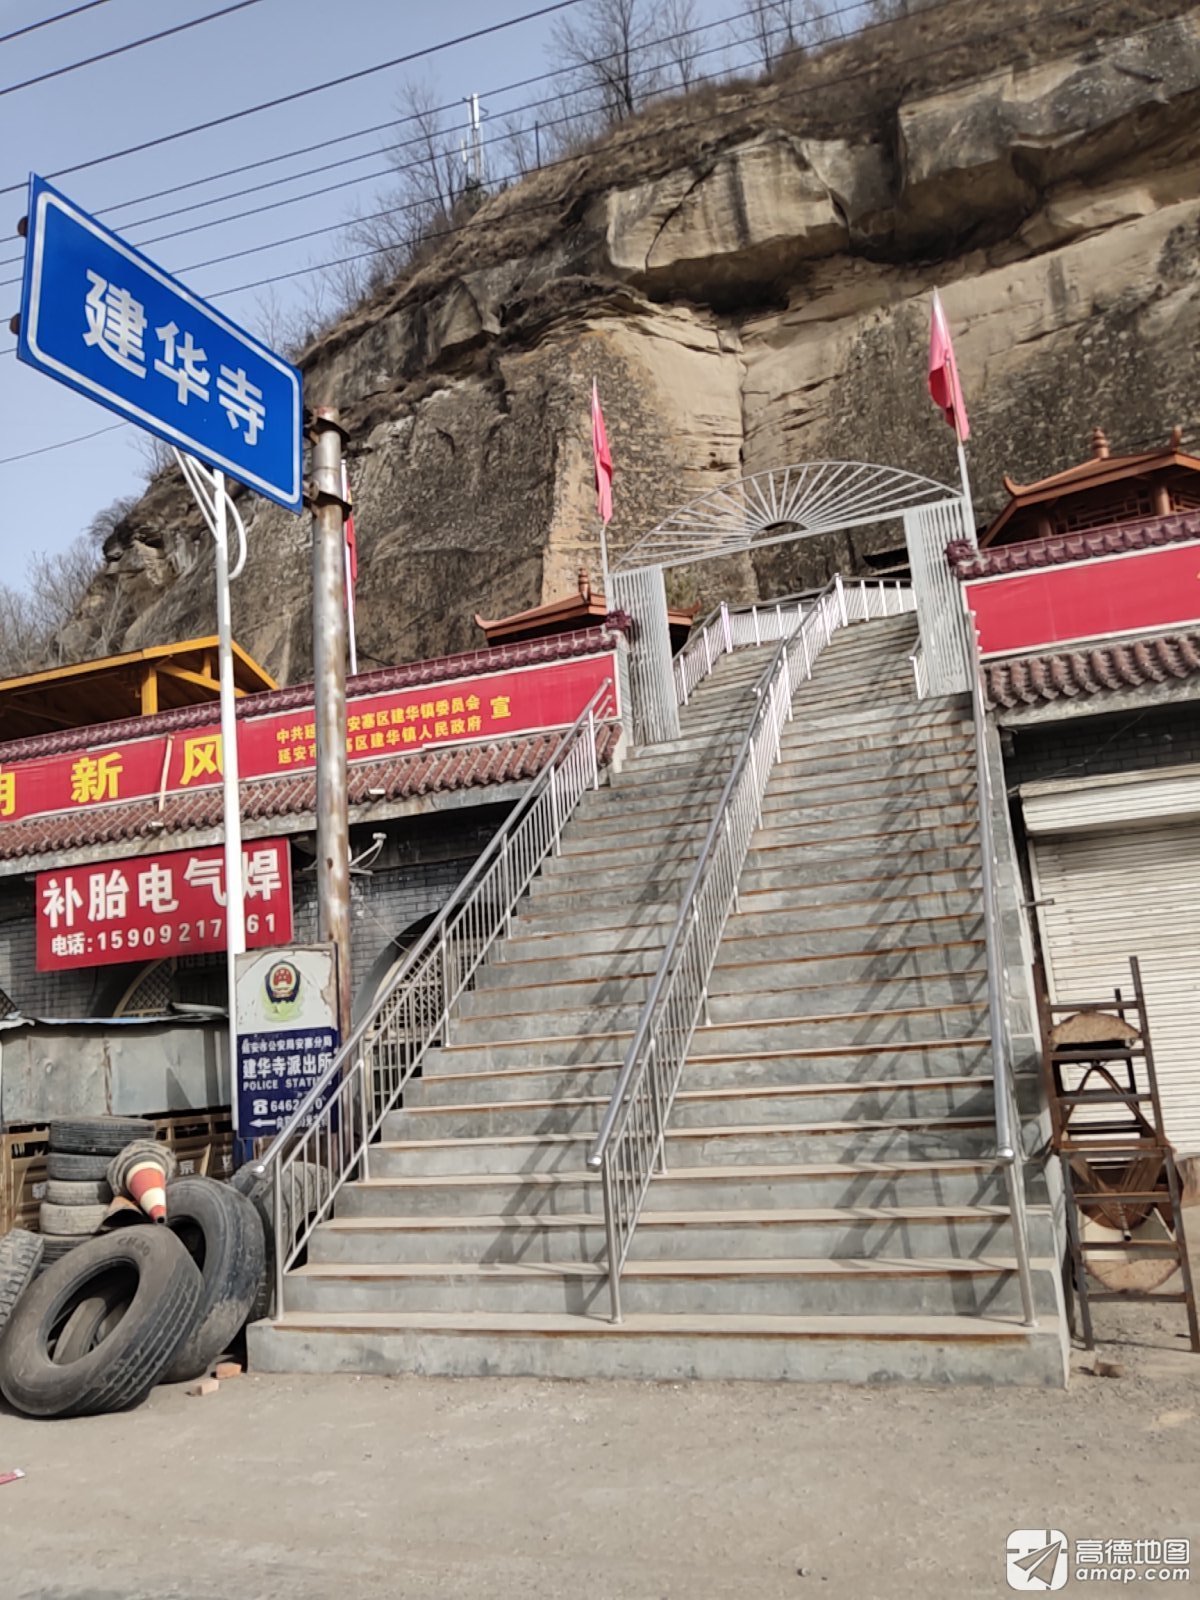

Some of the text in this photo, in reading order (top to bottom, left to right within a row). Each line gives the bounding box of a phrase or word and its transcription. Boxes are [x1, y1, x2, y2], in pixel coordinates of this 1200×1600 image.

[83, 268, 266, 446] 建华寺
[276, 694, 480, 744] 中共延安塞区建华镇委员会
[490, 695, 511, 719] 宣
[278, 715, 482, 765] 延安市区建华镇人民政府
[43, 848, 282, 928] 补胎电气焊
[51, 913, 275, 956] 电话:1590921761
[243, 1052, 332, 1079] 建华寺派出所
[243, 1080, 278, 1091] POLICE
[270, 1098, 323, 1112] 64620
